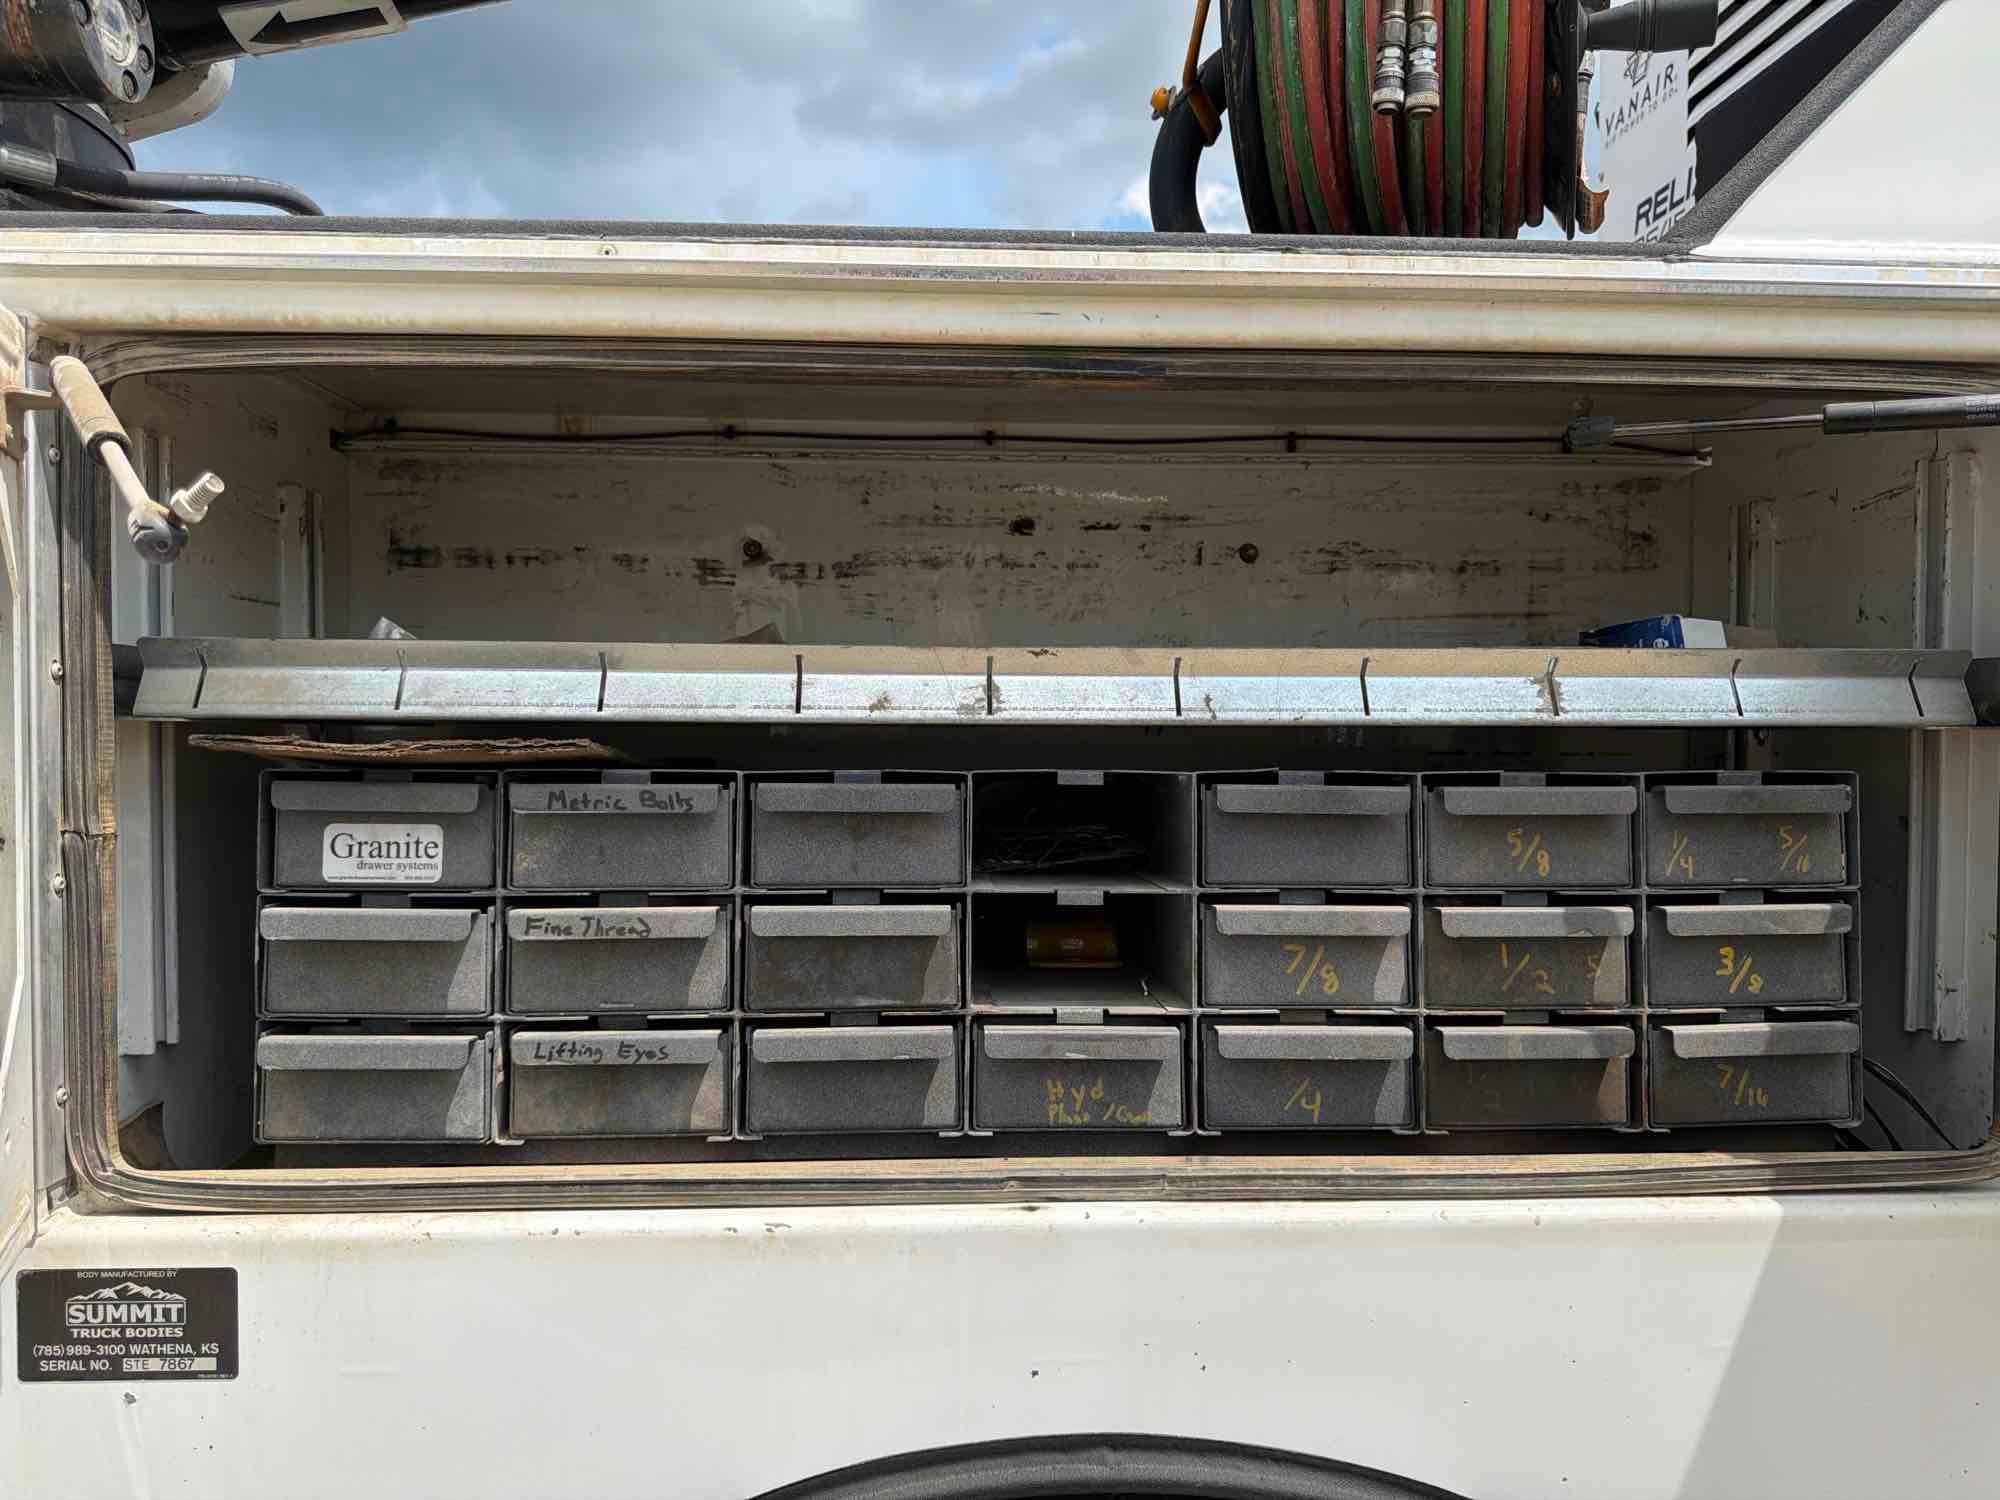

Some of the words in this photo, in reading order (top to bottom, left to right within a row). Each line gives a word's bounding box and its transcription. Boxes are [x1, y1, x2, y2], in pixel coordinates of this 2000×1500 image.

[1605, 63, 1674, 137] VANAIR
[1635, 166, 1696, 235] RELI
[547, 789, 628, 811] Metric
[639, 789, 694, 812] Bolts
[330, 832, 439, 859] Granite
[1508, 829, 1549, 878] 5/8
[356, 860, 394, 871] drawer
[396, 860, 439, 873] systems
[524, 916, 574, 936] Fine
[580, 916, 652, 937] Thread
[1280, 944, 1339, 995] 7/8
[1500, 942, 1555, 993] 1/2
[1715, 946, 1763, 993] 3/8
[534, 1041, 604, 1064] Lifting
[617, 1040, 669, 1065] Eyes
[77, 1271, 99, 1279] BODY
[100, 1270, 165, 1279] MANUFACTURED
[166, 1270, 177, 1278] BY
[68, 1303, 184, 1323] SUMMIT
[70, 1327, 122, 1339] TRUCK
[125, 1327, 184, 1338] BODIES
[129, 1343, 197, 1356] WATHENA,
[201, 1342, 219, 1354] KS
[40, 1360, 87, 1372] SERIAL
[89, 1359, 113, 1371] NO.
[124, 1359, 150, 1371] STE
[160, 1358, 195, 1370] 7867
